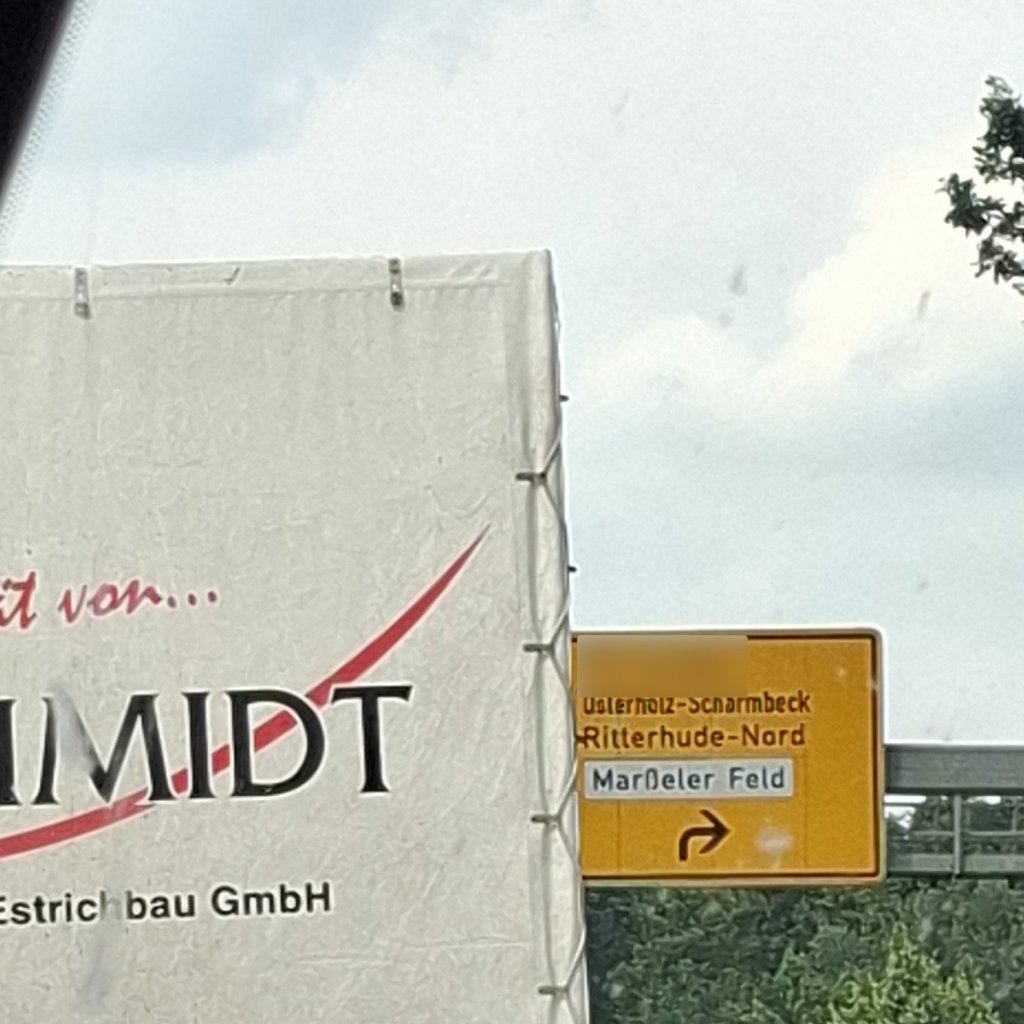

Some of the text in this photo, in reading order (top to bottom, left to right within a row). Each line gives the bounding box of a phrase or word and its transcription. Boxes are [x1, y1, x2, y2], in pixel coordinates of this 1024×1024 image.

[583, 722, 806, 749] Ritterhude-Nord
[592, 765, 785, 791] Marßeler Feld
[211, 881, 331, 916] GmbH
